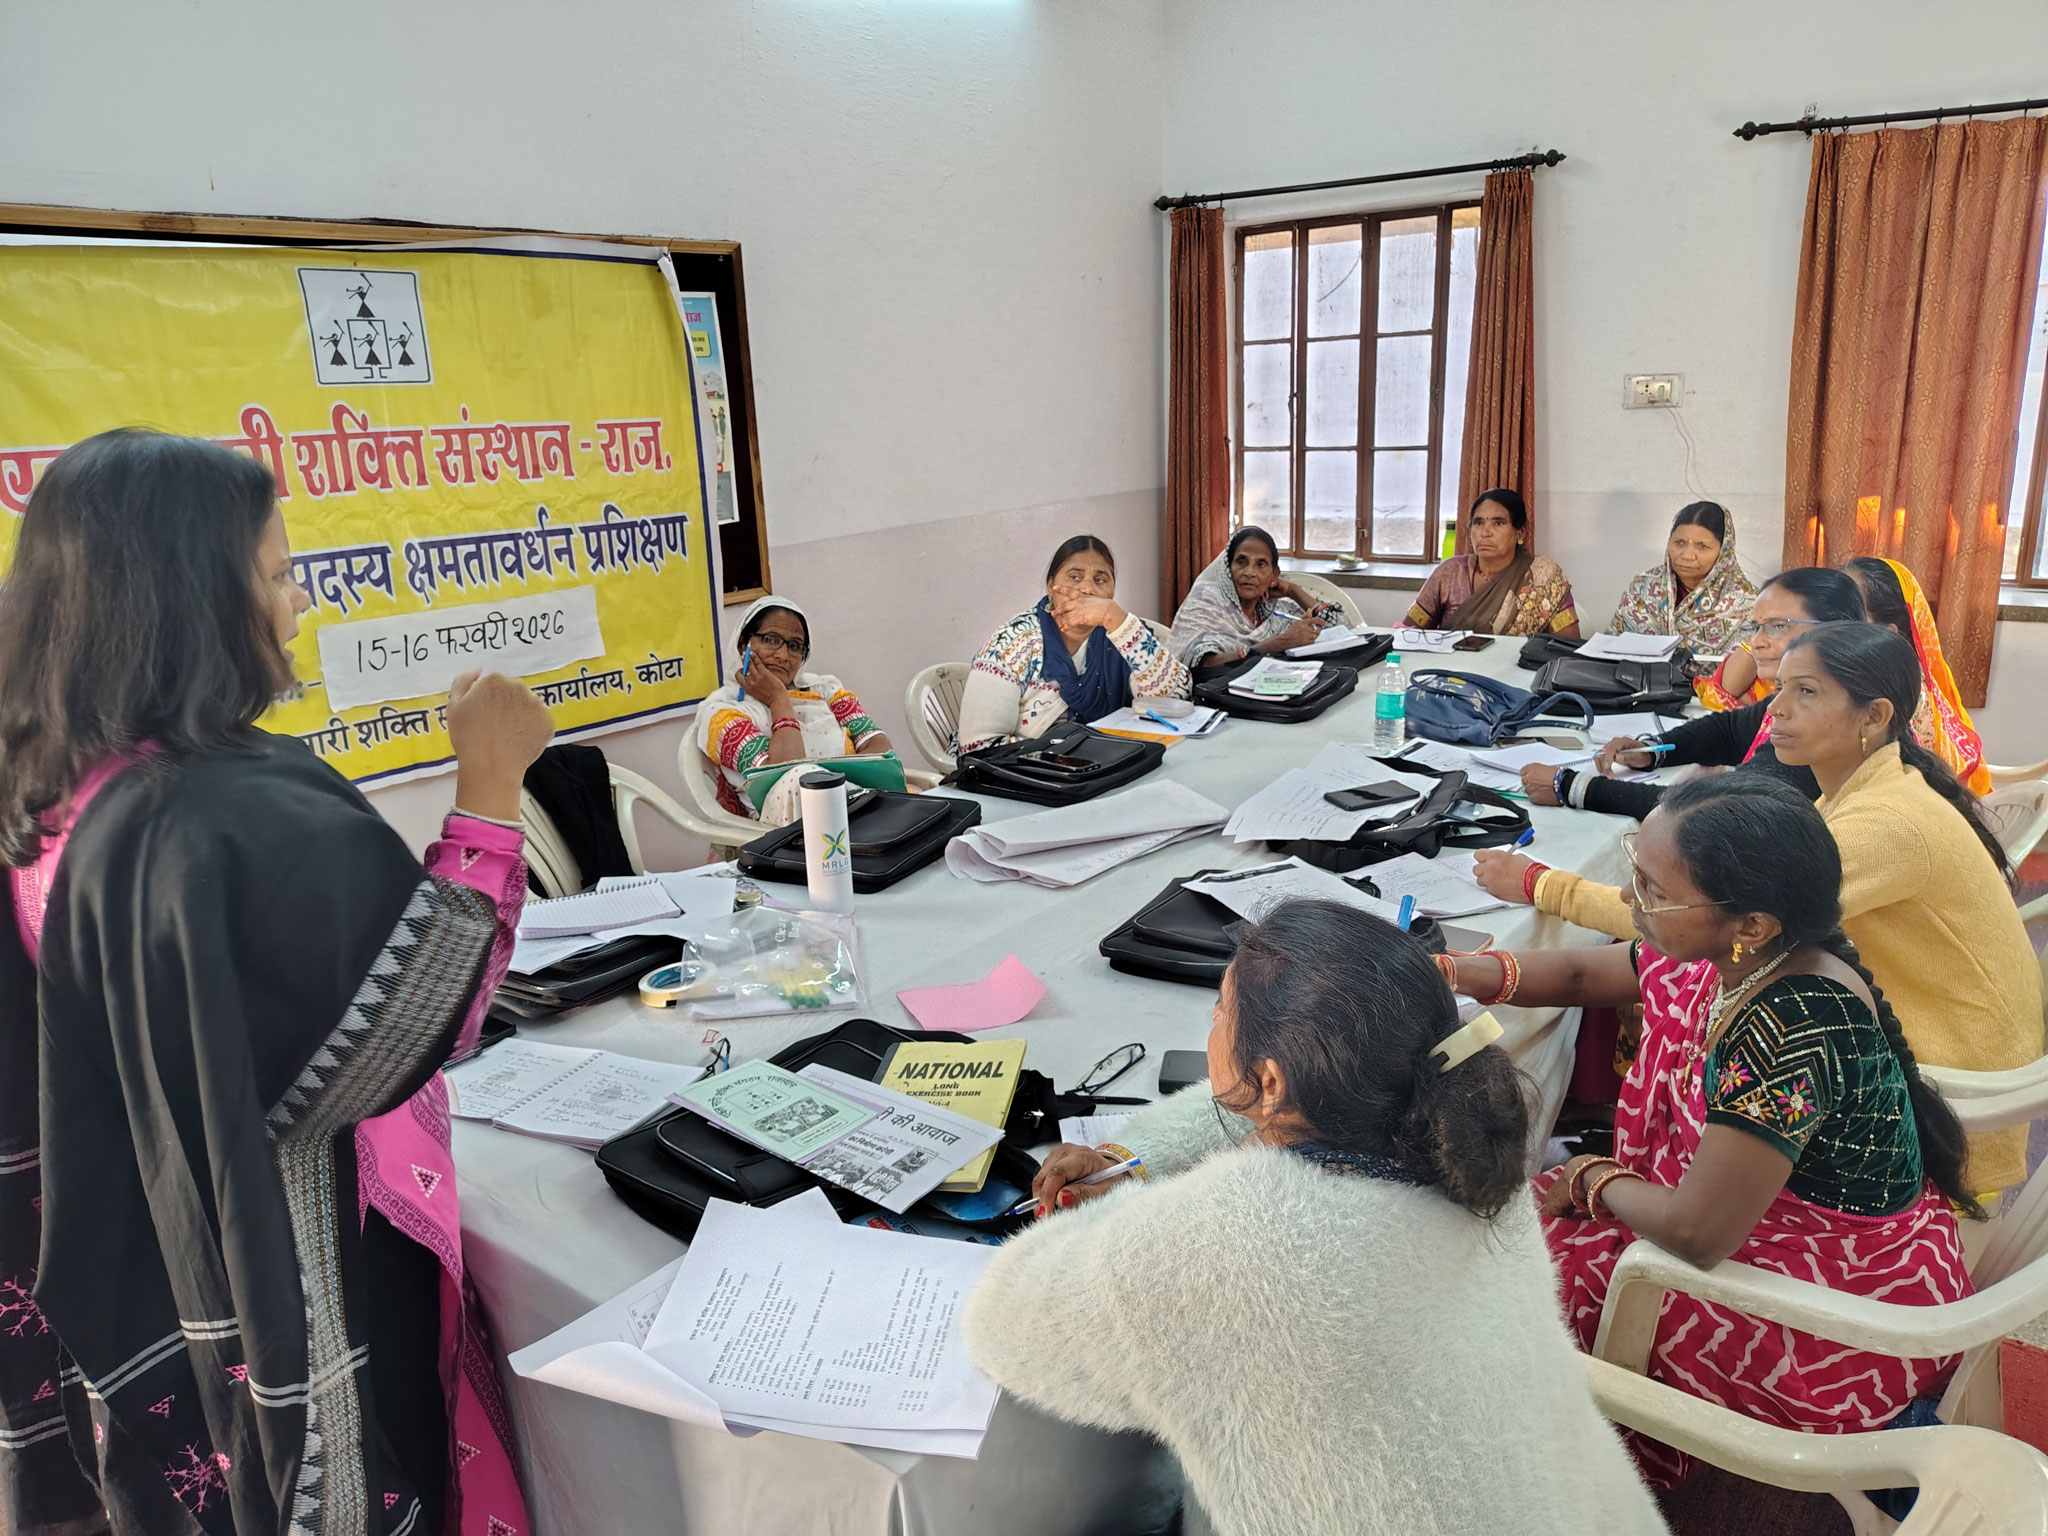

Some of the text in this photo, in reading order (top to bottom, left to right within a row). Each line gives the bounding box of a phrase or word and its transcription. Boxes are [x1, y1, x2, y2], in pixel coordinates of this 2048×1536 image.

[291, 404, 429, 496] शक्ति
[432, 407, 573, 482] संस्थान
[597, 421, 671, 473] राज.
[406, 510, 575, 602] क्षमतावर्धन
[580, 507, 687, 573] प्रशिक्षण
[357, 632, 428, 673] 15-16
[353, 706, 430, 748] शक्ति
[635, 653, 683, 684] कोटा
[898, 1061, 1004, 1080] NATIONAL
[891, 1114, 961, 1146] की आवाज
